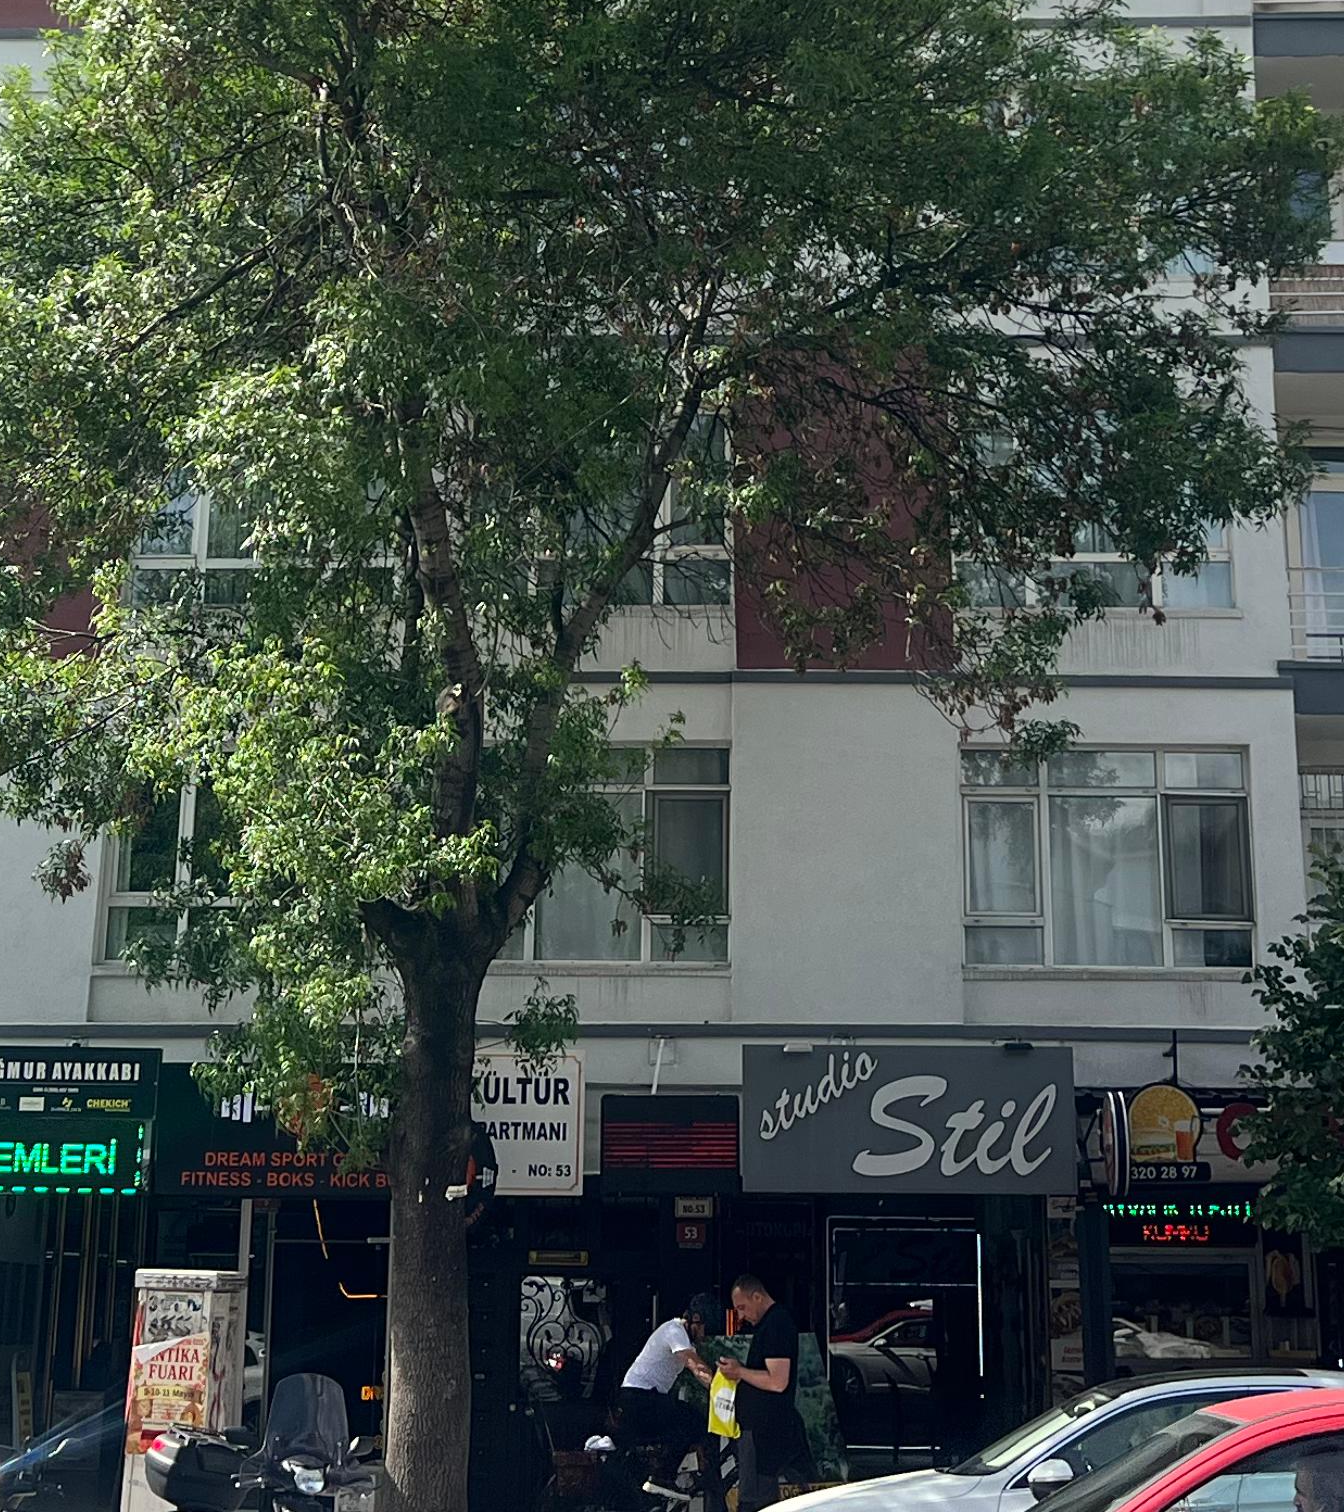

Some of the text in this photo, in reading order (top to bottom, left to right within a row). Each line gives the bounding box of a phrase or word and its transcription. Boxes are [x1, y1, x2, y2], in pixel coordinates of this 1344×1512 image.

[51, 1061, 141, 1082] AYAKKABI
[478, 1071, 570, 1106] ÜLTÜR
[759, 1051, 878, 1140] studio
[852, 1074, 1057, 1177] Stil
[204, 1151, 267, 1167] DREAM
[270, 1151, 327, 1167] SPORT
[555, 1164, 572, 1177] 53
[1130, 1166, 1198, 1179] 320 28 97
[180, 1171, 253, 1187] FITNESS
[266, 1172, 315, 1187] BOKS
[329, 1173, 371, 1188] KICK
[684, 1226, 698, 1239] 53
[148, 1363, 195, 1381] FUARI
